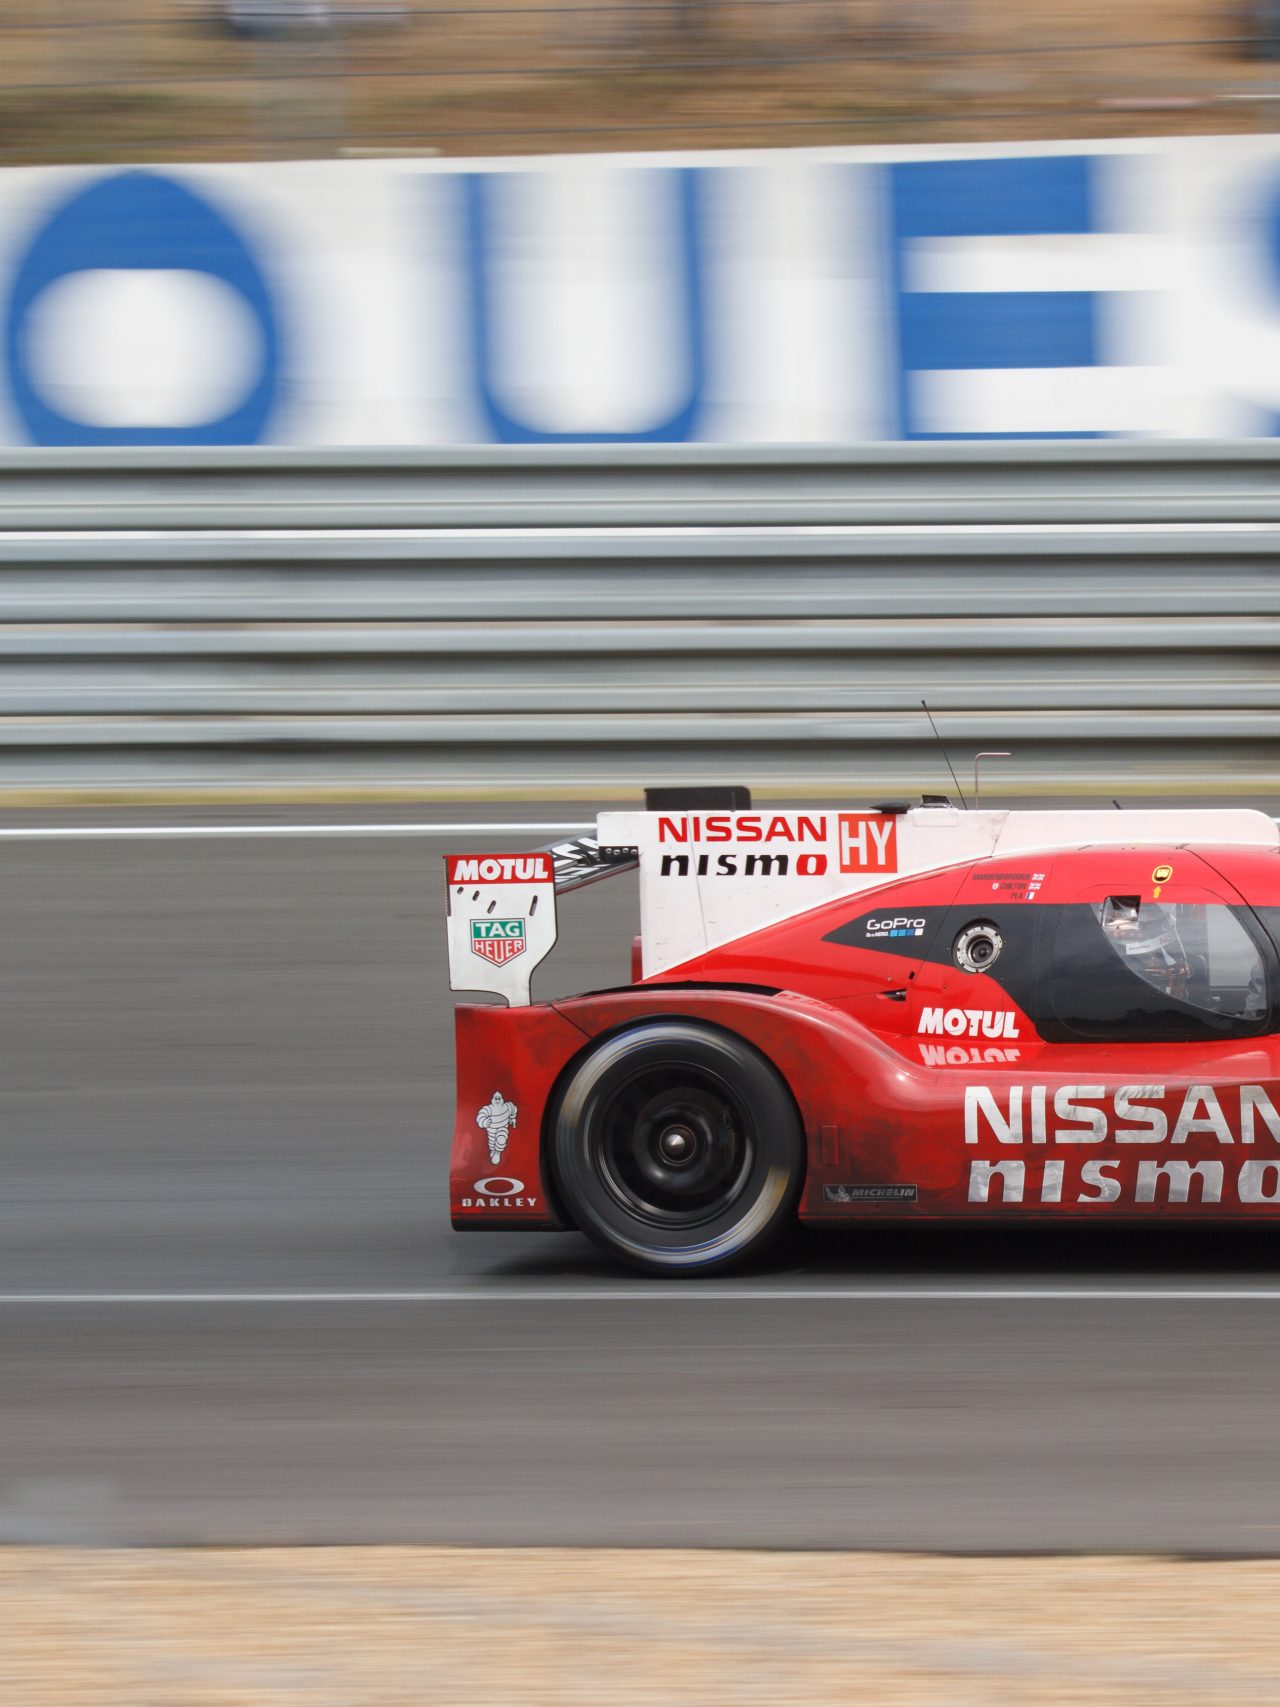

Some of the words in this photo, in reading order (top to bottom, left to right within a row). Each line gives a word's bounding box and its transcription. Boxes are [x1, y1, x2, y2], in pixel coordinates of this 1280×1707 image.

[658, 816, 827, 843] NISSAN
[840, 820, 894, 866] HY
[453, 858, 549, 881] MOTUL
[660, 854, 828, 876] nismo
[475, 922, 521, 937] TAG
[866, 917, 926, 930] GoPro
[475, 939, 523, 964] HEUER
[917, 1007, 1020, 1039] MOTUL
[461, 1197, 537, 1207] OAKLEY
[852, 1188, 915, 1197] MICHELIN
